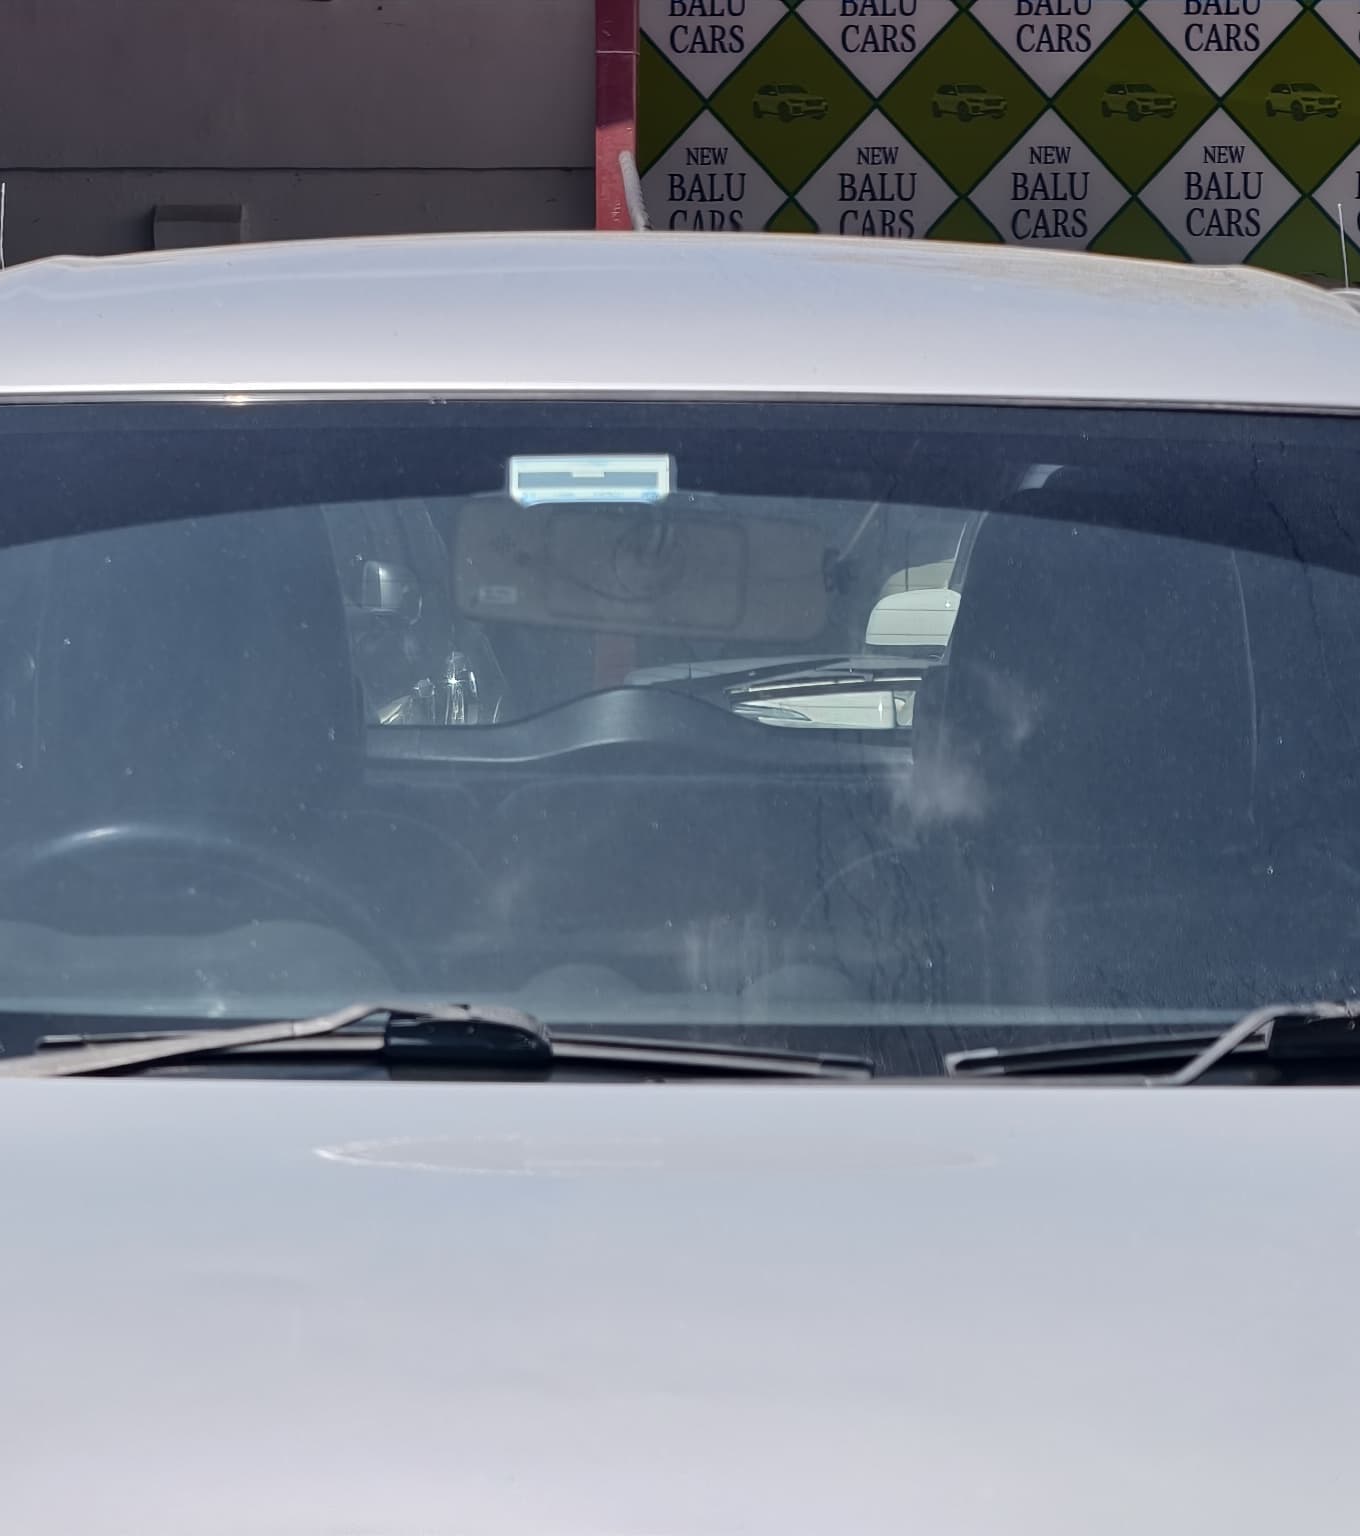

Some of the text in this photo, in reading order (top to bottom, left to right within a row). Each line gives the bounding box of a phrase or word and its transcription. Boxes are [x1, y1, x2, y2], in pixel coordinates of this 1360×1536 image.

[670, 25, 744, 53] CARS
[842, 24, 916, 52] CARS
[1016, 24, 1091, 52] CARS
[1185, 23, 1260, 51] CARS
[686, 147, 728, 165] NEW
[857, 147, 899, 165] NEW
[1030, 146, 1071, 164] NEW
[1203, 145, 1245, 163] NEW
[668, 173, 746, 202] BALU
[838, 173, 917, 201] BALU
[1011, 172, 1090, 200] BALU
[1185, 172, 1263, 200] BALU
[669, 210, 743, 231] CARS
[840, 209, 915, 238] CARS
[1012, 209, 1088, 239] CARS
[1186, 208, 1261, 237] CARS
